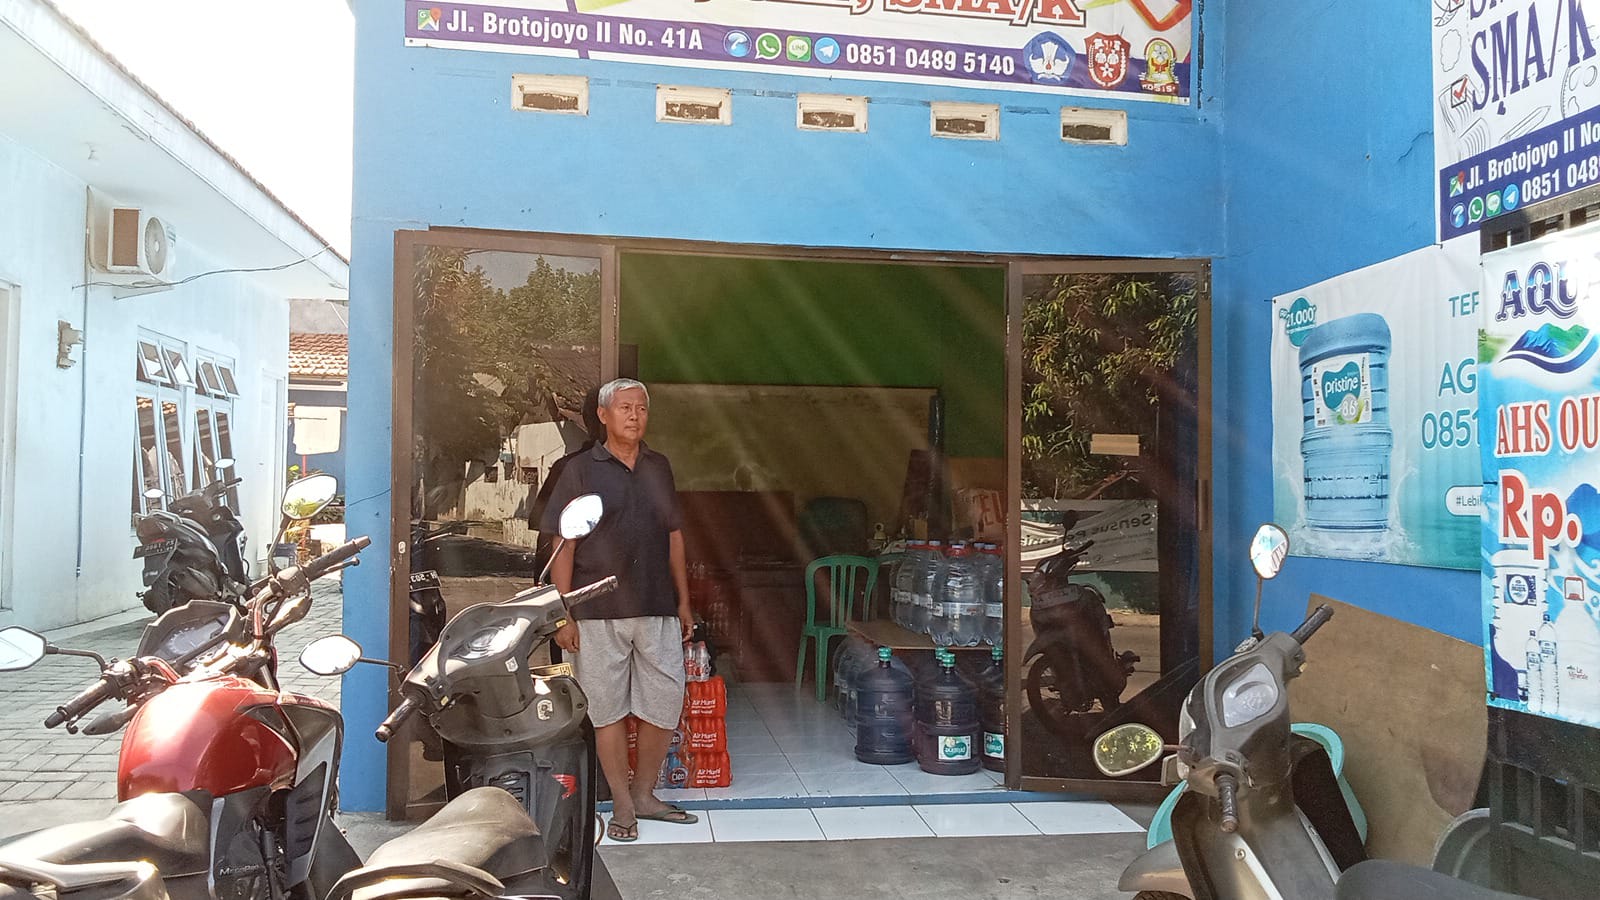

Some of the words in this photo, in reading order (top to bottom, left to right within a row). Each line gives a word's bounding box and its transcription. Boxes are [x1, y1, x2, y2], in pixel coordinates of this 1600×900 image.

[446, 9, 475, 32] Jl.
[483, 12, 588, 44] Brotojoyo
[596, 21, 611, 43] II
[619, 23, 654, 47] No.
[660, 27, 703, 50] 41A
[846, 43, 896, 66] 0851
[905, 48, 957, 71] 0489
[963, 52, 1015, 75] 5140
[1466, 165, 1484, 190] Jl.
[1488, 140, 1559, 182] Brotojoyo
[1563, 127, 1575, 154] II
[1522, 168, 1560, 203] 0851
[1567, 155, 1600, 188] 048
[1495, 261, 1590, 320] AQU
[1324, 376, 1360, 398] pristine
[1438, 358, 1477, 397] AG
[1497, 403, 1550, 455] AHS
[1560, 396, 1600, 450] OU
[1502, 474, 1578, 560] Rp.
